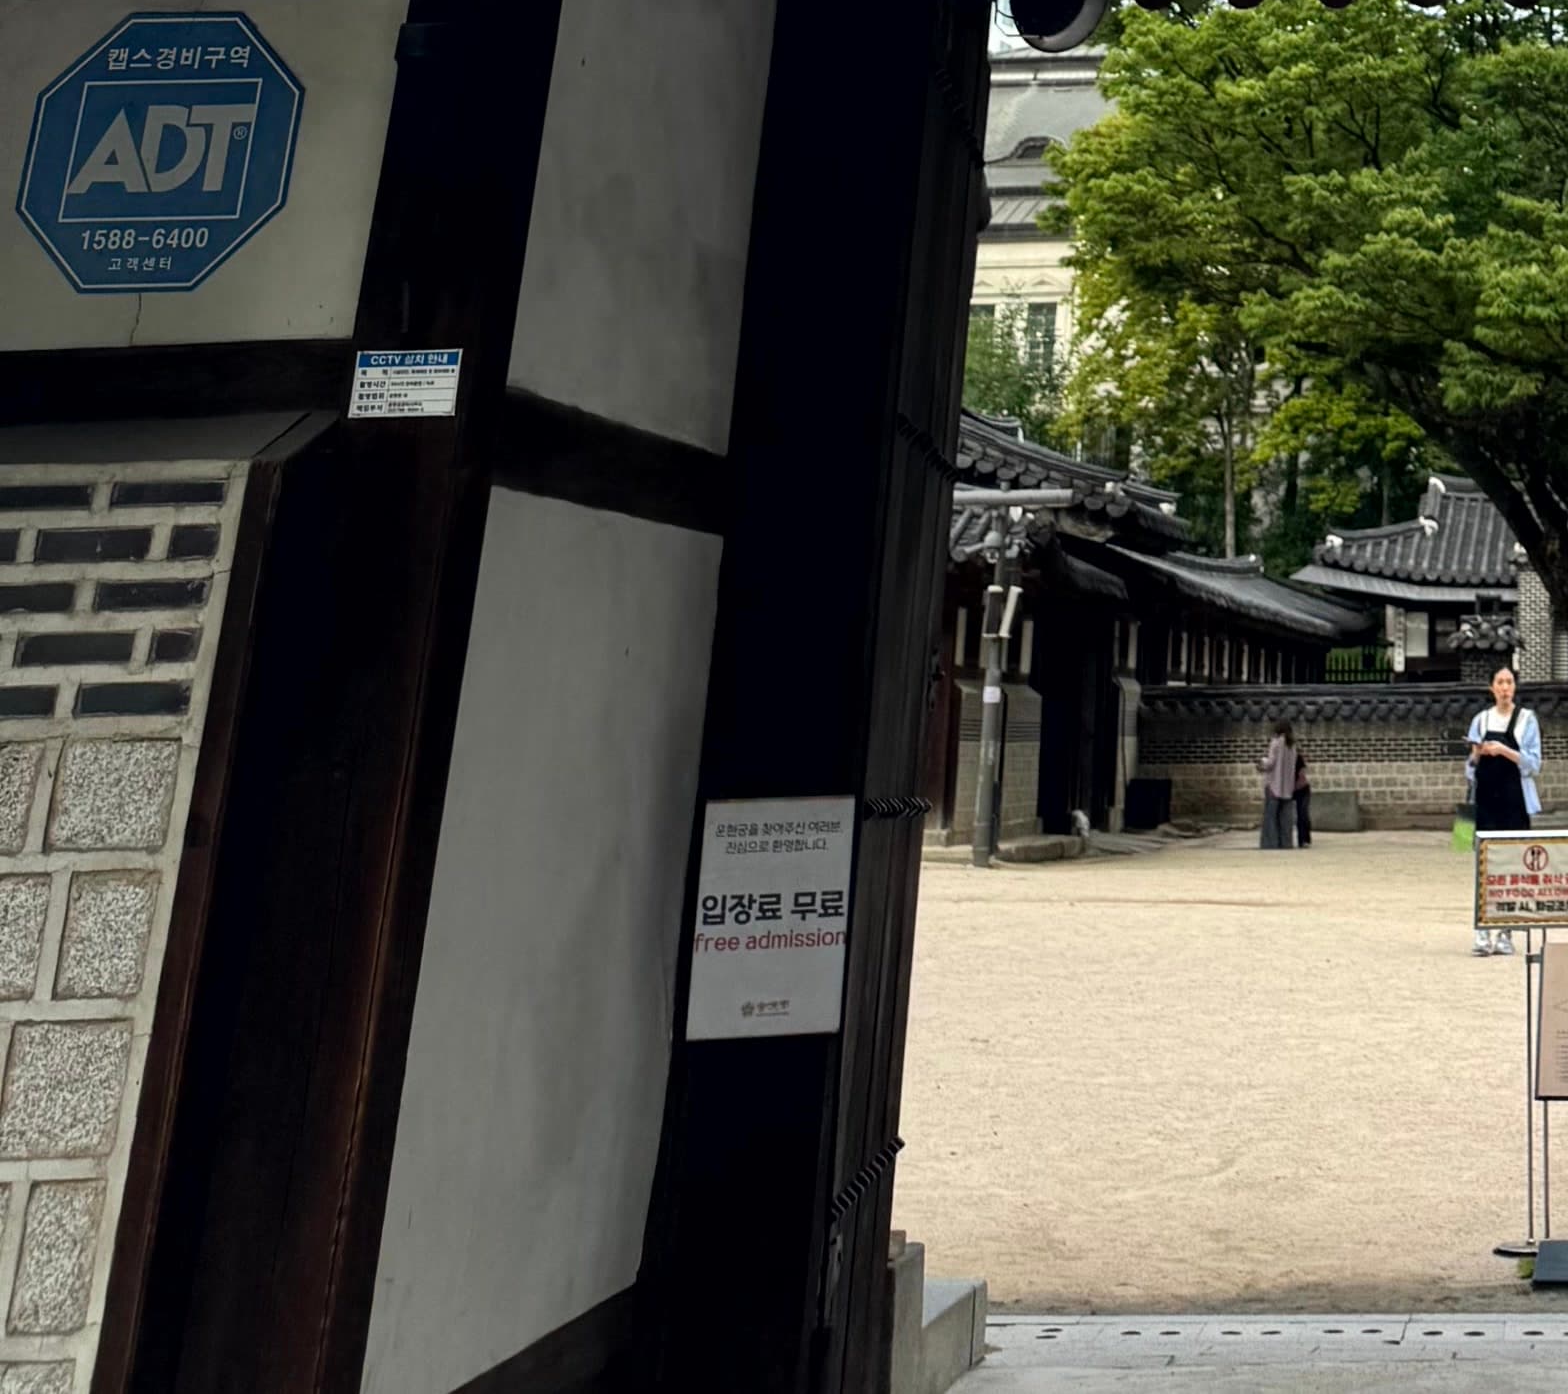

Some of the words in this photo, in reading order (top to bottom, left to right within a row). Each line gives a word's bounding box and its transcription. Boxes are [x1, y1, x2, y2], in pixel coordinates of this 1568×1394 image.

[107, 45, 252, 72] 캡스경비구역
[67, 103, 257, 194] ADT
[81, 227, 209, 251] 1588-6400
[107, 255, 173, 272] 고객센터
[370, 356, 402, 366] CCTV
[404, 354, 425, 365] 설치
[427, 354, 449, 364] 안내
[715, 822, 759, 838] 운현궁을
[725, 839, 769, 854] 진심으로
[701, 893, 782, 926] 입장료
[790, 889, 845, 921] 무료
[694, 933, 740, 953] free
[745, 928, 847, 951] admission
